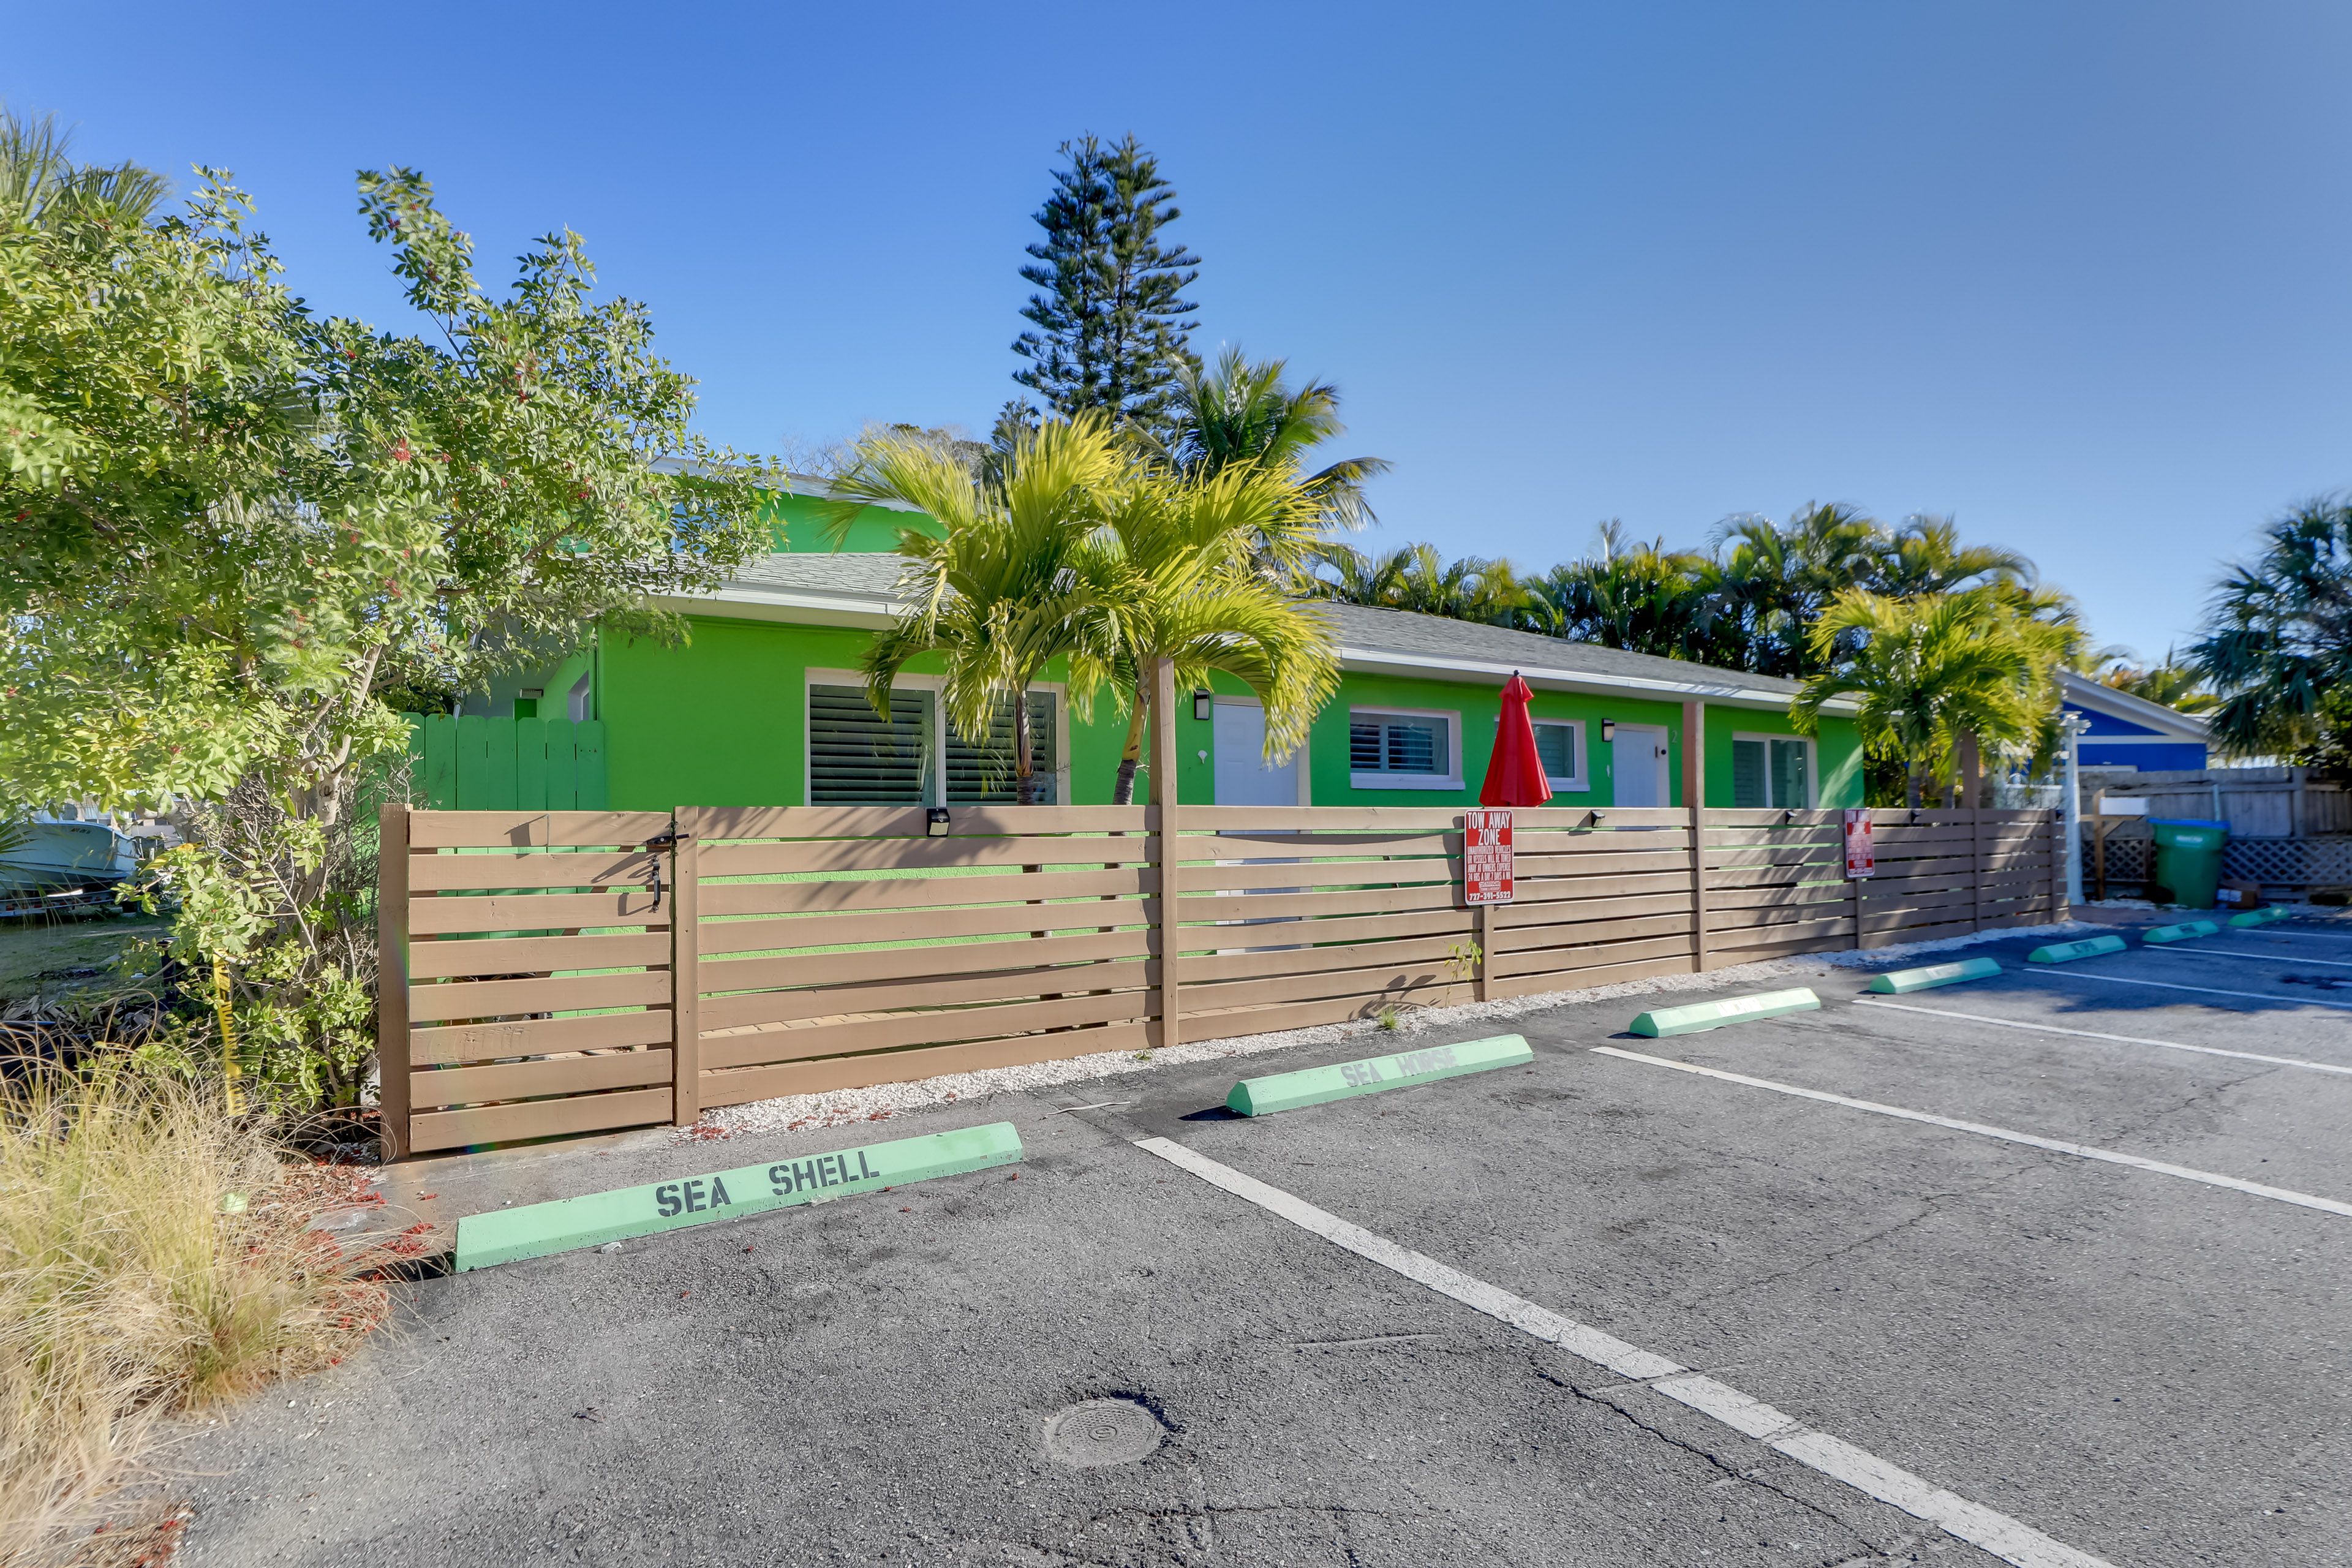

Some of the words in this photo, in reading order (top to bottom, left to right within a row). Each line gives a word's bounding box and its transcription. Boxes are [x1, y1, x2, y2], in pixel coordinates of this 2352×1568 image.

[1672, 729, 1678, 743] 2
[1468, 812, 1485, 829] TOW
[1488, 812, 1511, 829] AWAY
[1478, 829, 1501, 845] ZONE
[1494, 845, 1511, 854] VEHICLES
[1473, 854, 1487, 864] VESSELS
[1469, 891, 1511, 901] 727-391-5522
[1340, 1061, 1384, 1088] SEA
[1395, 1048, 1460, 1078] HORSE
[655, 1176, 732, 1217] SEA
[769, 1150, 881, 1196] SHELL
